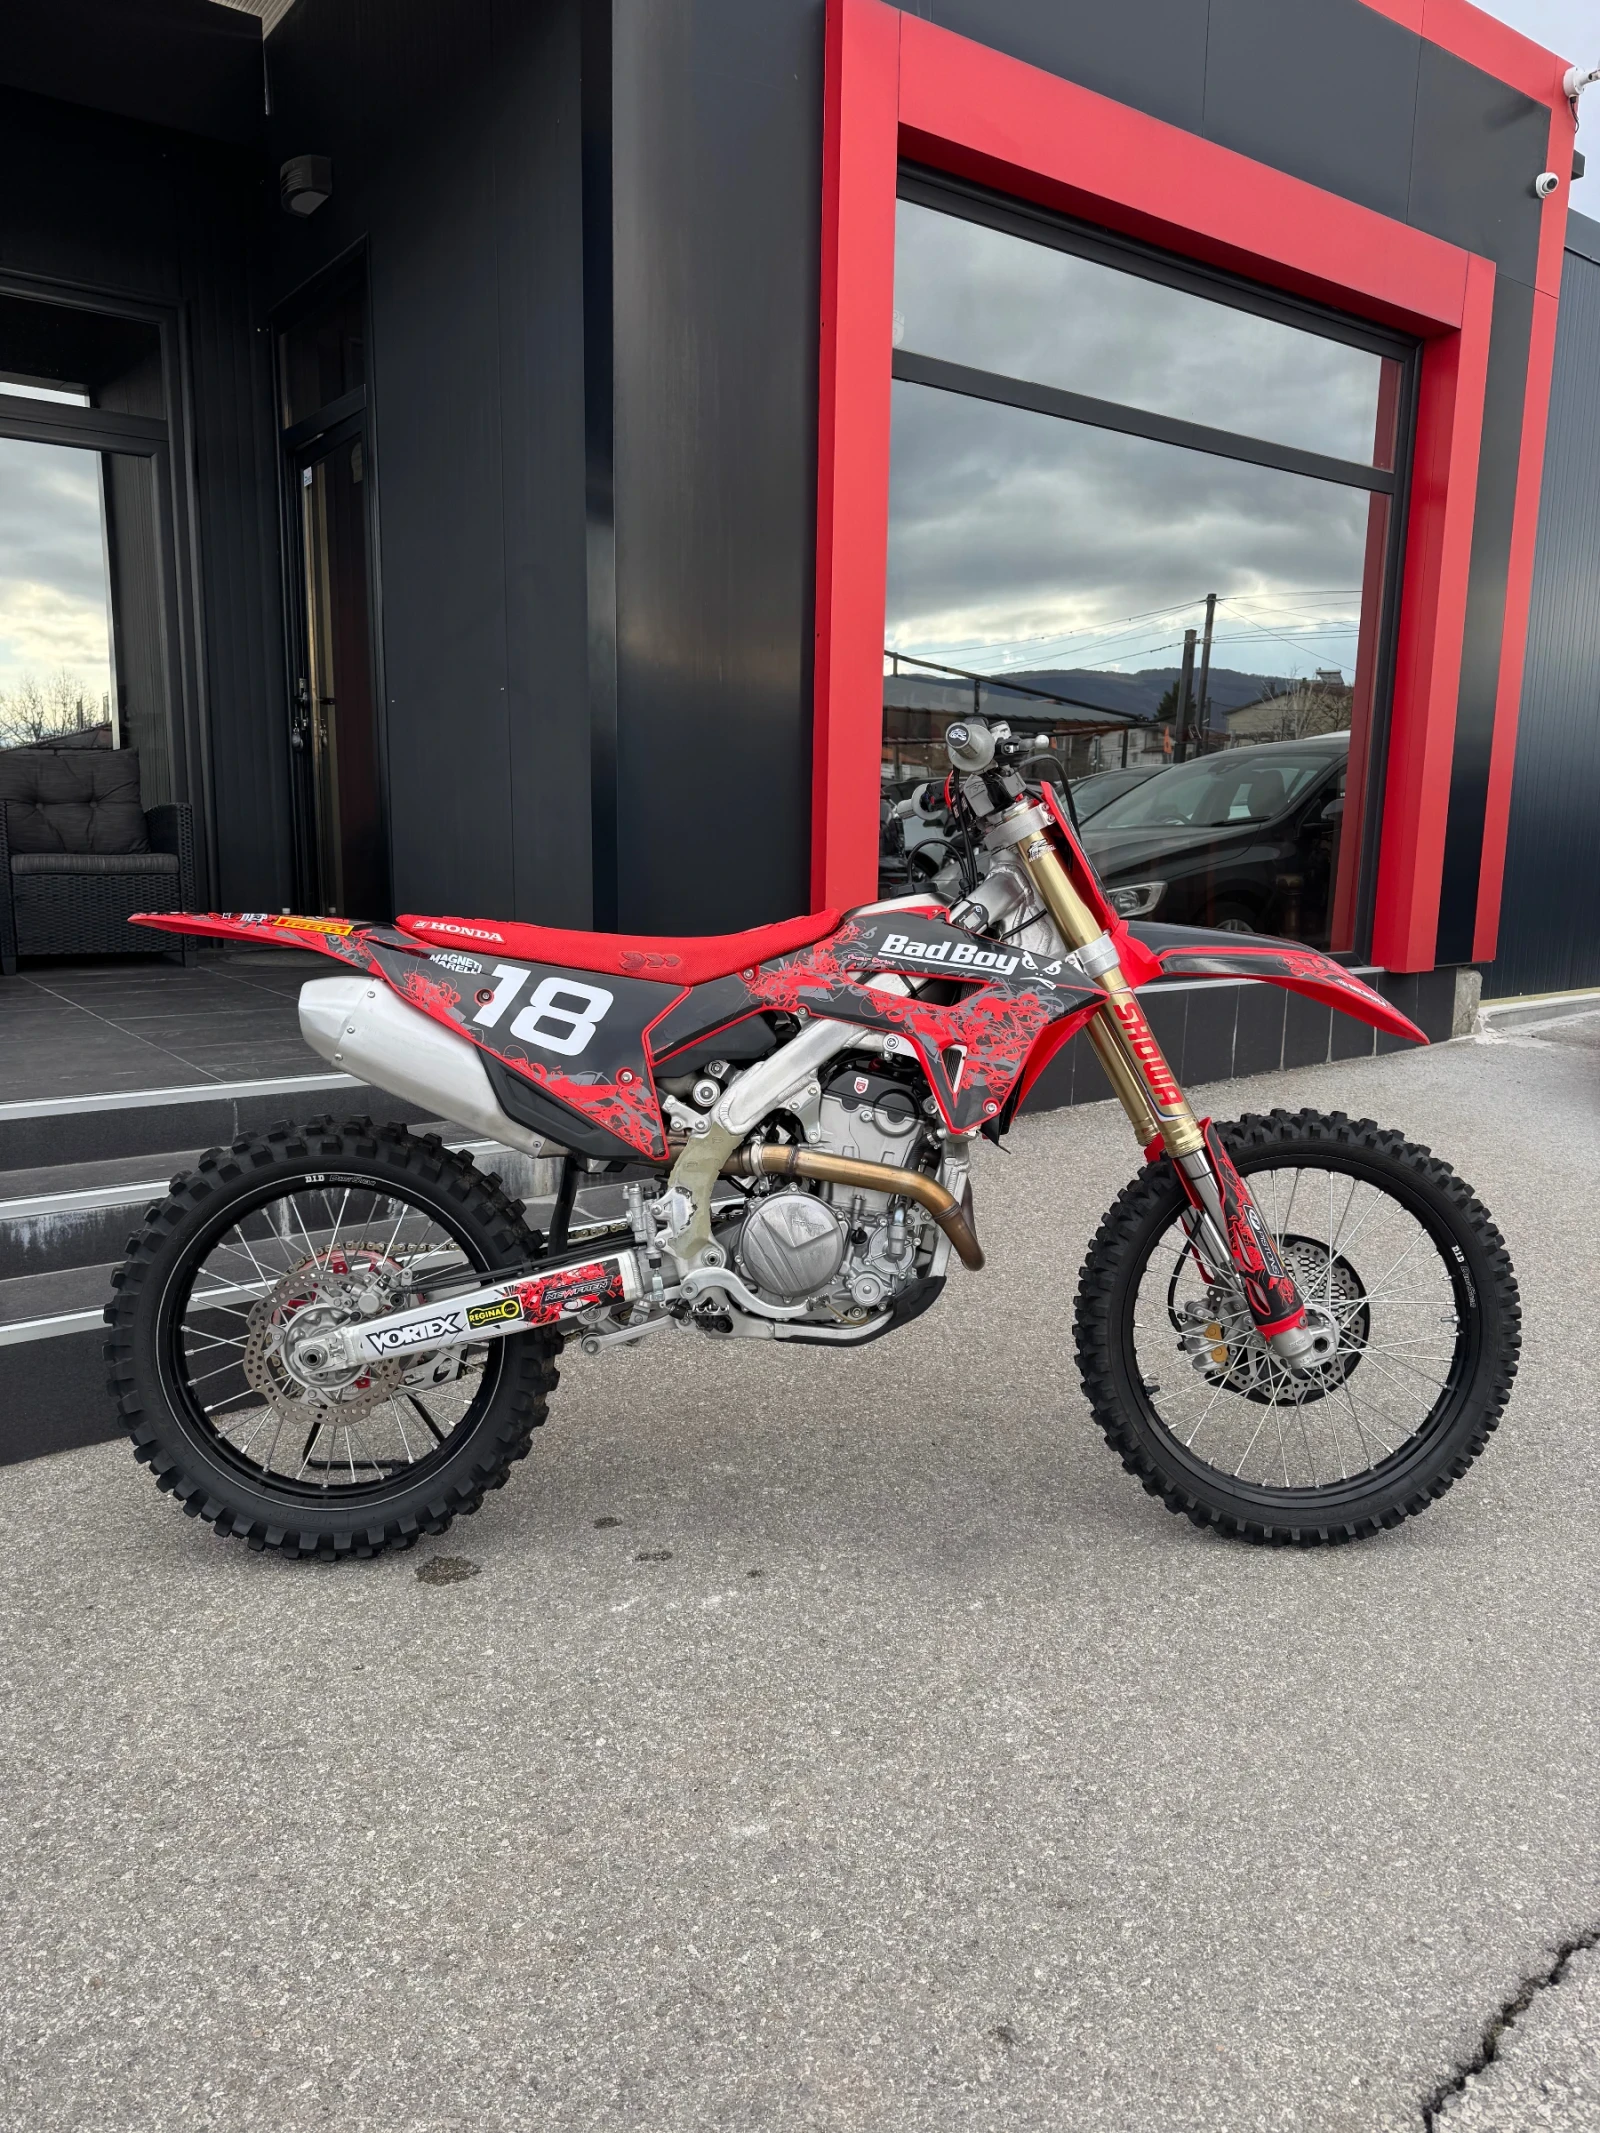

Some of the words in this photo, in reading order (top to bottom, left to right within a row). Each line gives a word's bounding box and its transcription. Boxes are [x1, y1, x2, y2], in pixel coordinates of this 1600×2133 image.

[430, 921, 504, 942] HONDA
[429, 953, 482, 969] MAGNETI
[472, 964, 614, 1056] 18
[1113, 1002, 1183, 1106] SHOWA
[468, 1308, 502, 1322] REGINA
[366, 1312, 463, 1355] VORTEX
